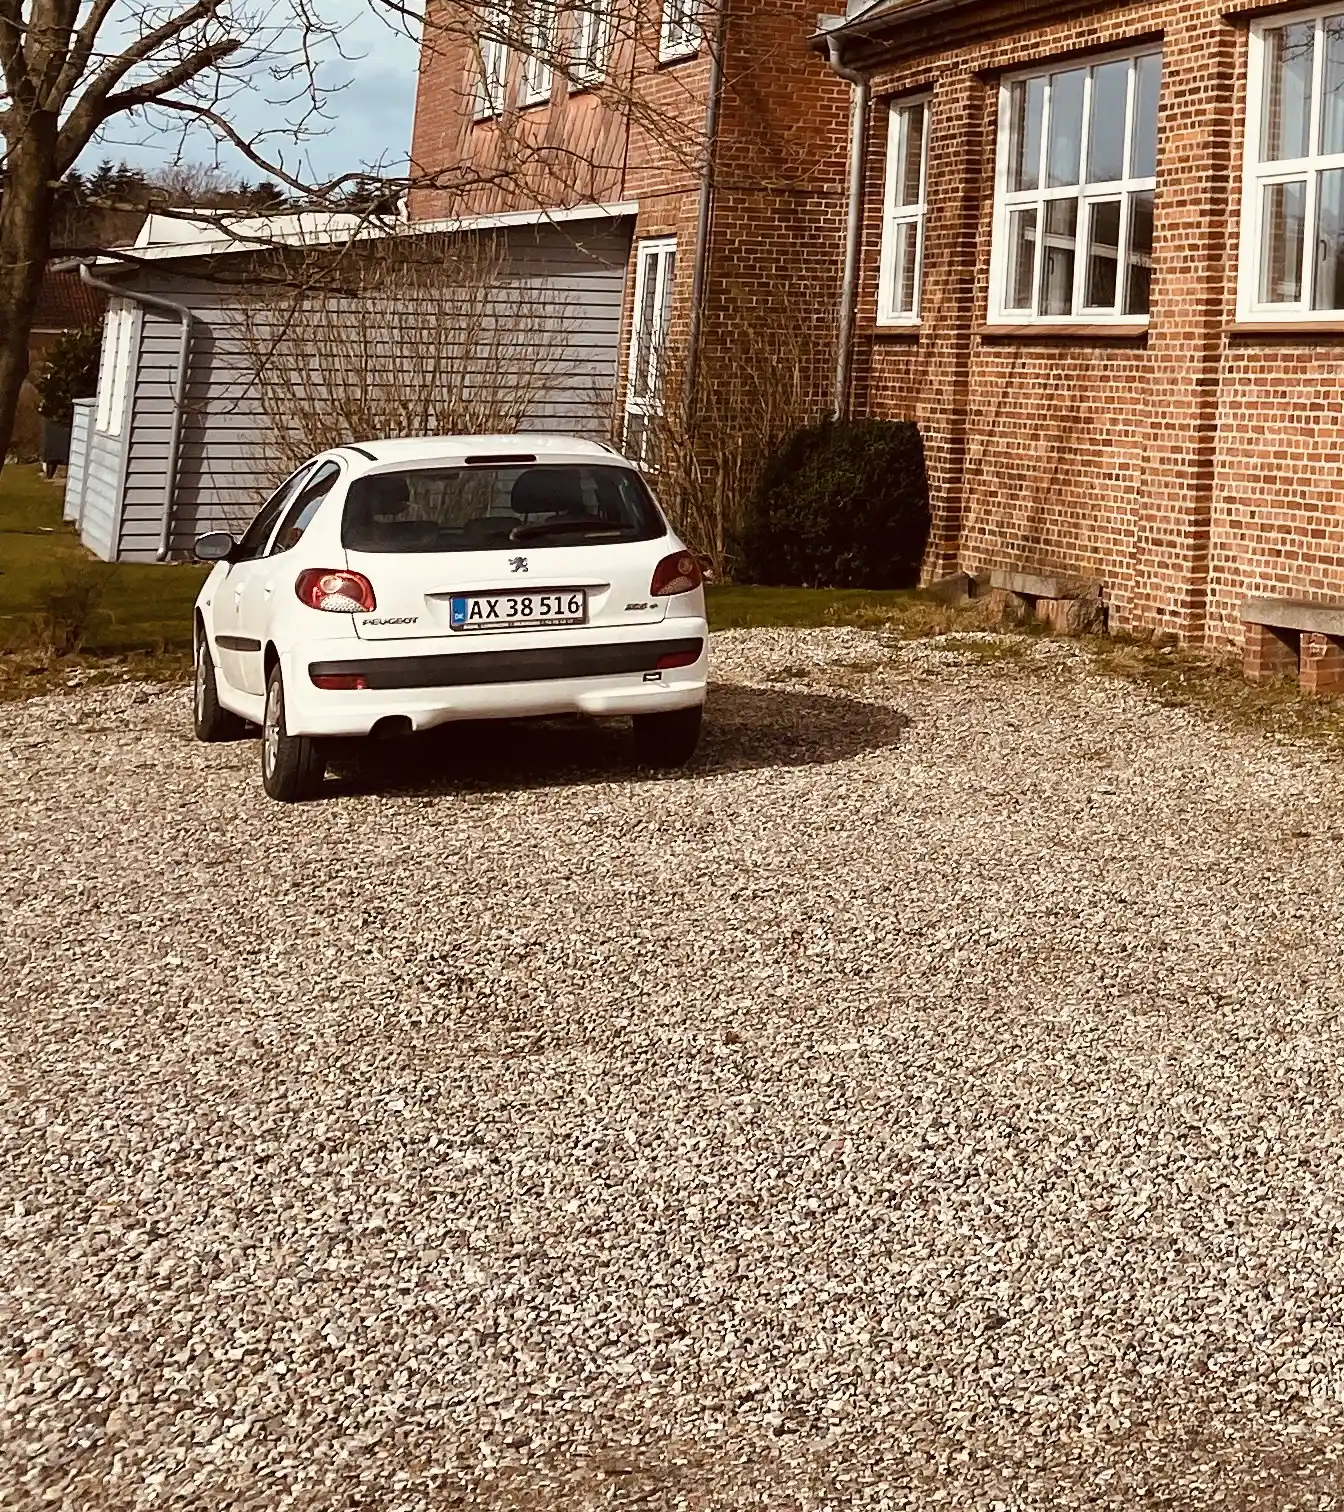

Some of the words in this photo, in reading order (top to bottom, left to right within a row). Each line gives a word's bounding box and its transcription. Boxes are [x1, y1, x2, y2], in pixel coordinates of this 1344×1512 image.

[469, 599, 500, 619] AX
[506, 597, 534, 617] 38
[539, 594, 580, 615] 516
[362, 616, 419, 626] PEUGEOT
